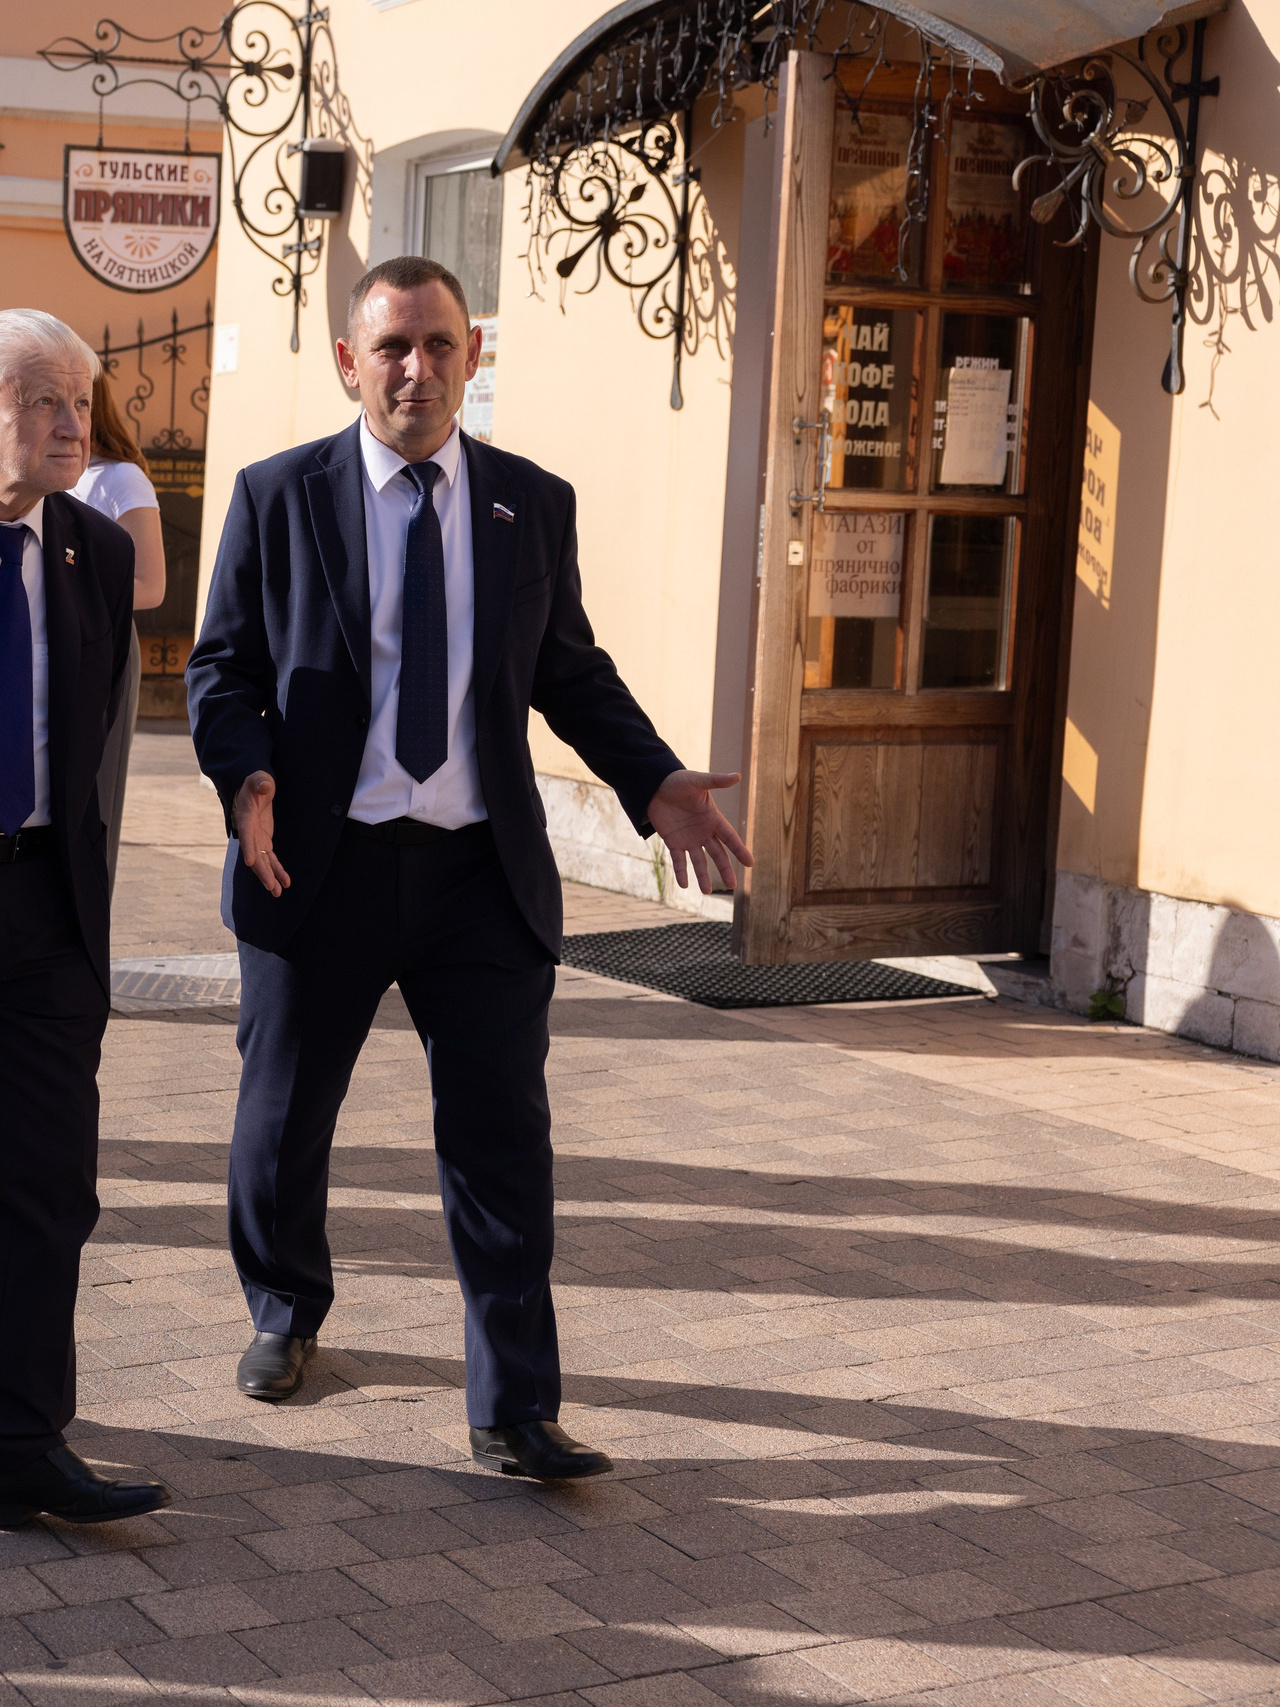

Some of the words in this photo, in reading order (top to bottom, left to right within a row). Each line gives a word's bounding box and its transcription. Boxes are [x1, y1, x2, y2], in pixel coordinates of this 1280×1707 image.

[99, 161, 189, 183] ТУЛЬСКИЕ
[73, 189, 211, 228] ПРЯНИКИ
[83, 238, 101, 265] НА
[103, 242, 199, 284] ПЯТНИЦКОЙ
[843, 322, 889, 352] ЧАЙ
[832, 361, 895, 389] КОФЕ
[955, 356, 999, 369] РЕЖИМ
[831, 399, 890, 429] ВОДА
[825, 574, 900, 600] фабрики
